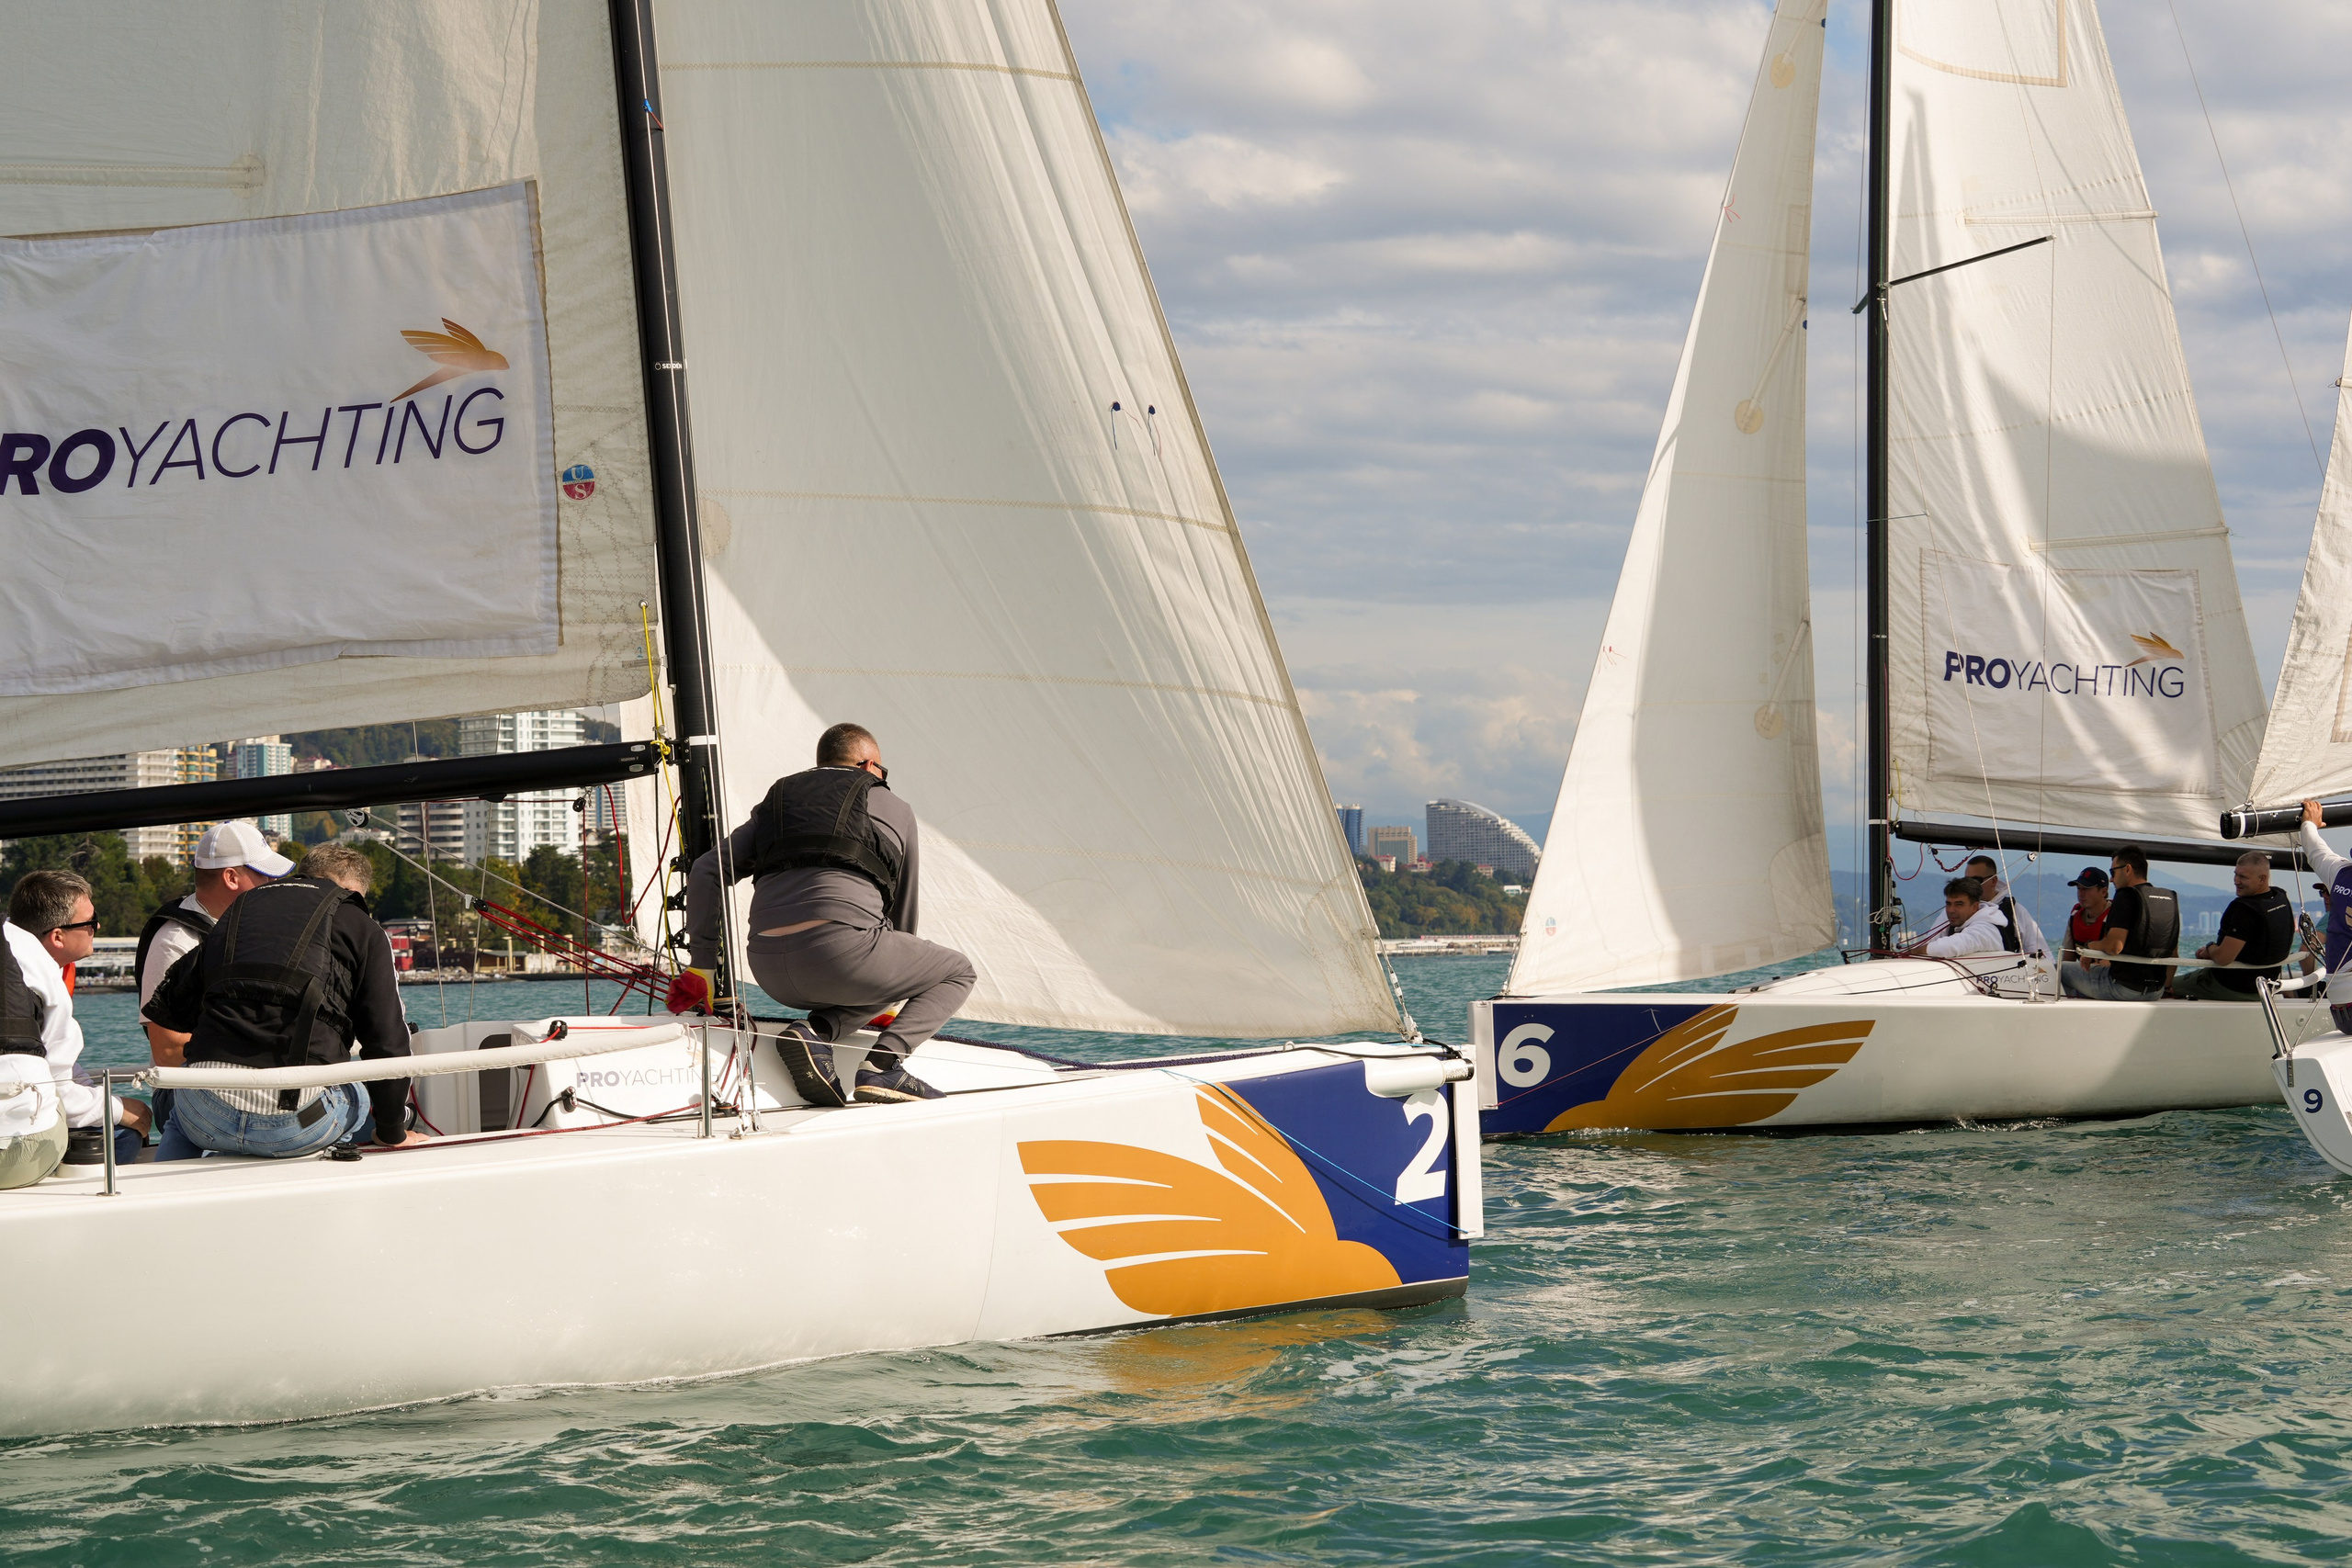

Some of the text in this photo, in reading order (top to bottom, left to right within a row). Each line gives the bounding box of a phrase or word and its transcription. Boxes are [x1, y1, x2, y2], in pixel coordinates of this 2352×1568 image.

[1943, 650, 2185, 698] PROYACHTING
[1976, 975, 2049, 983] PROYACHNG
[1498, 1022, 1555, 1088] 6
[2303, 1089, 2323, 1113] 9
[1394, 1089, 1450, 1206] 2
